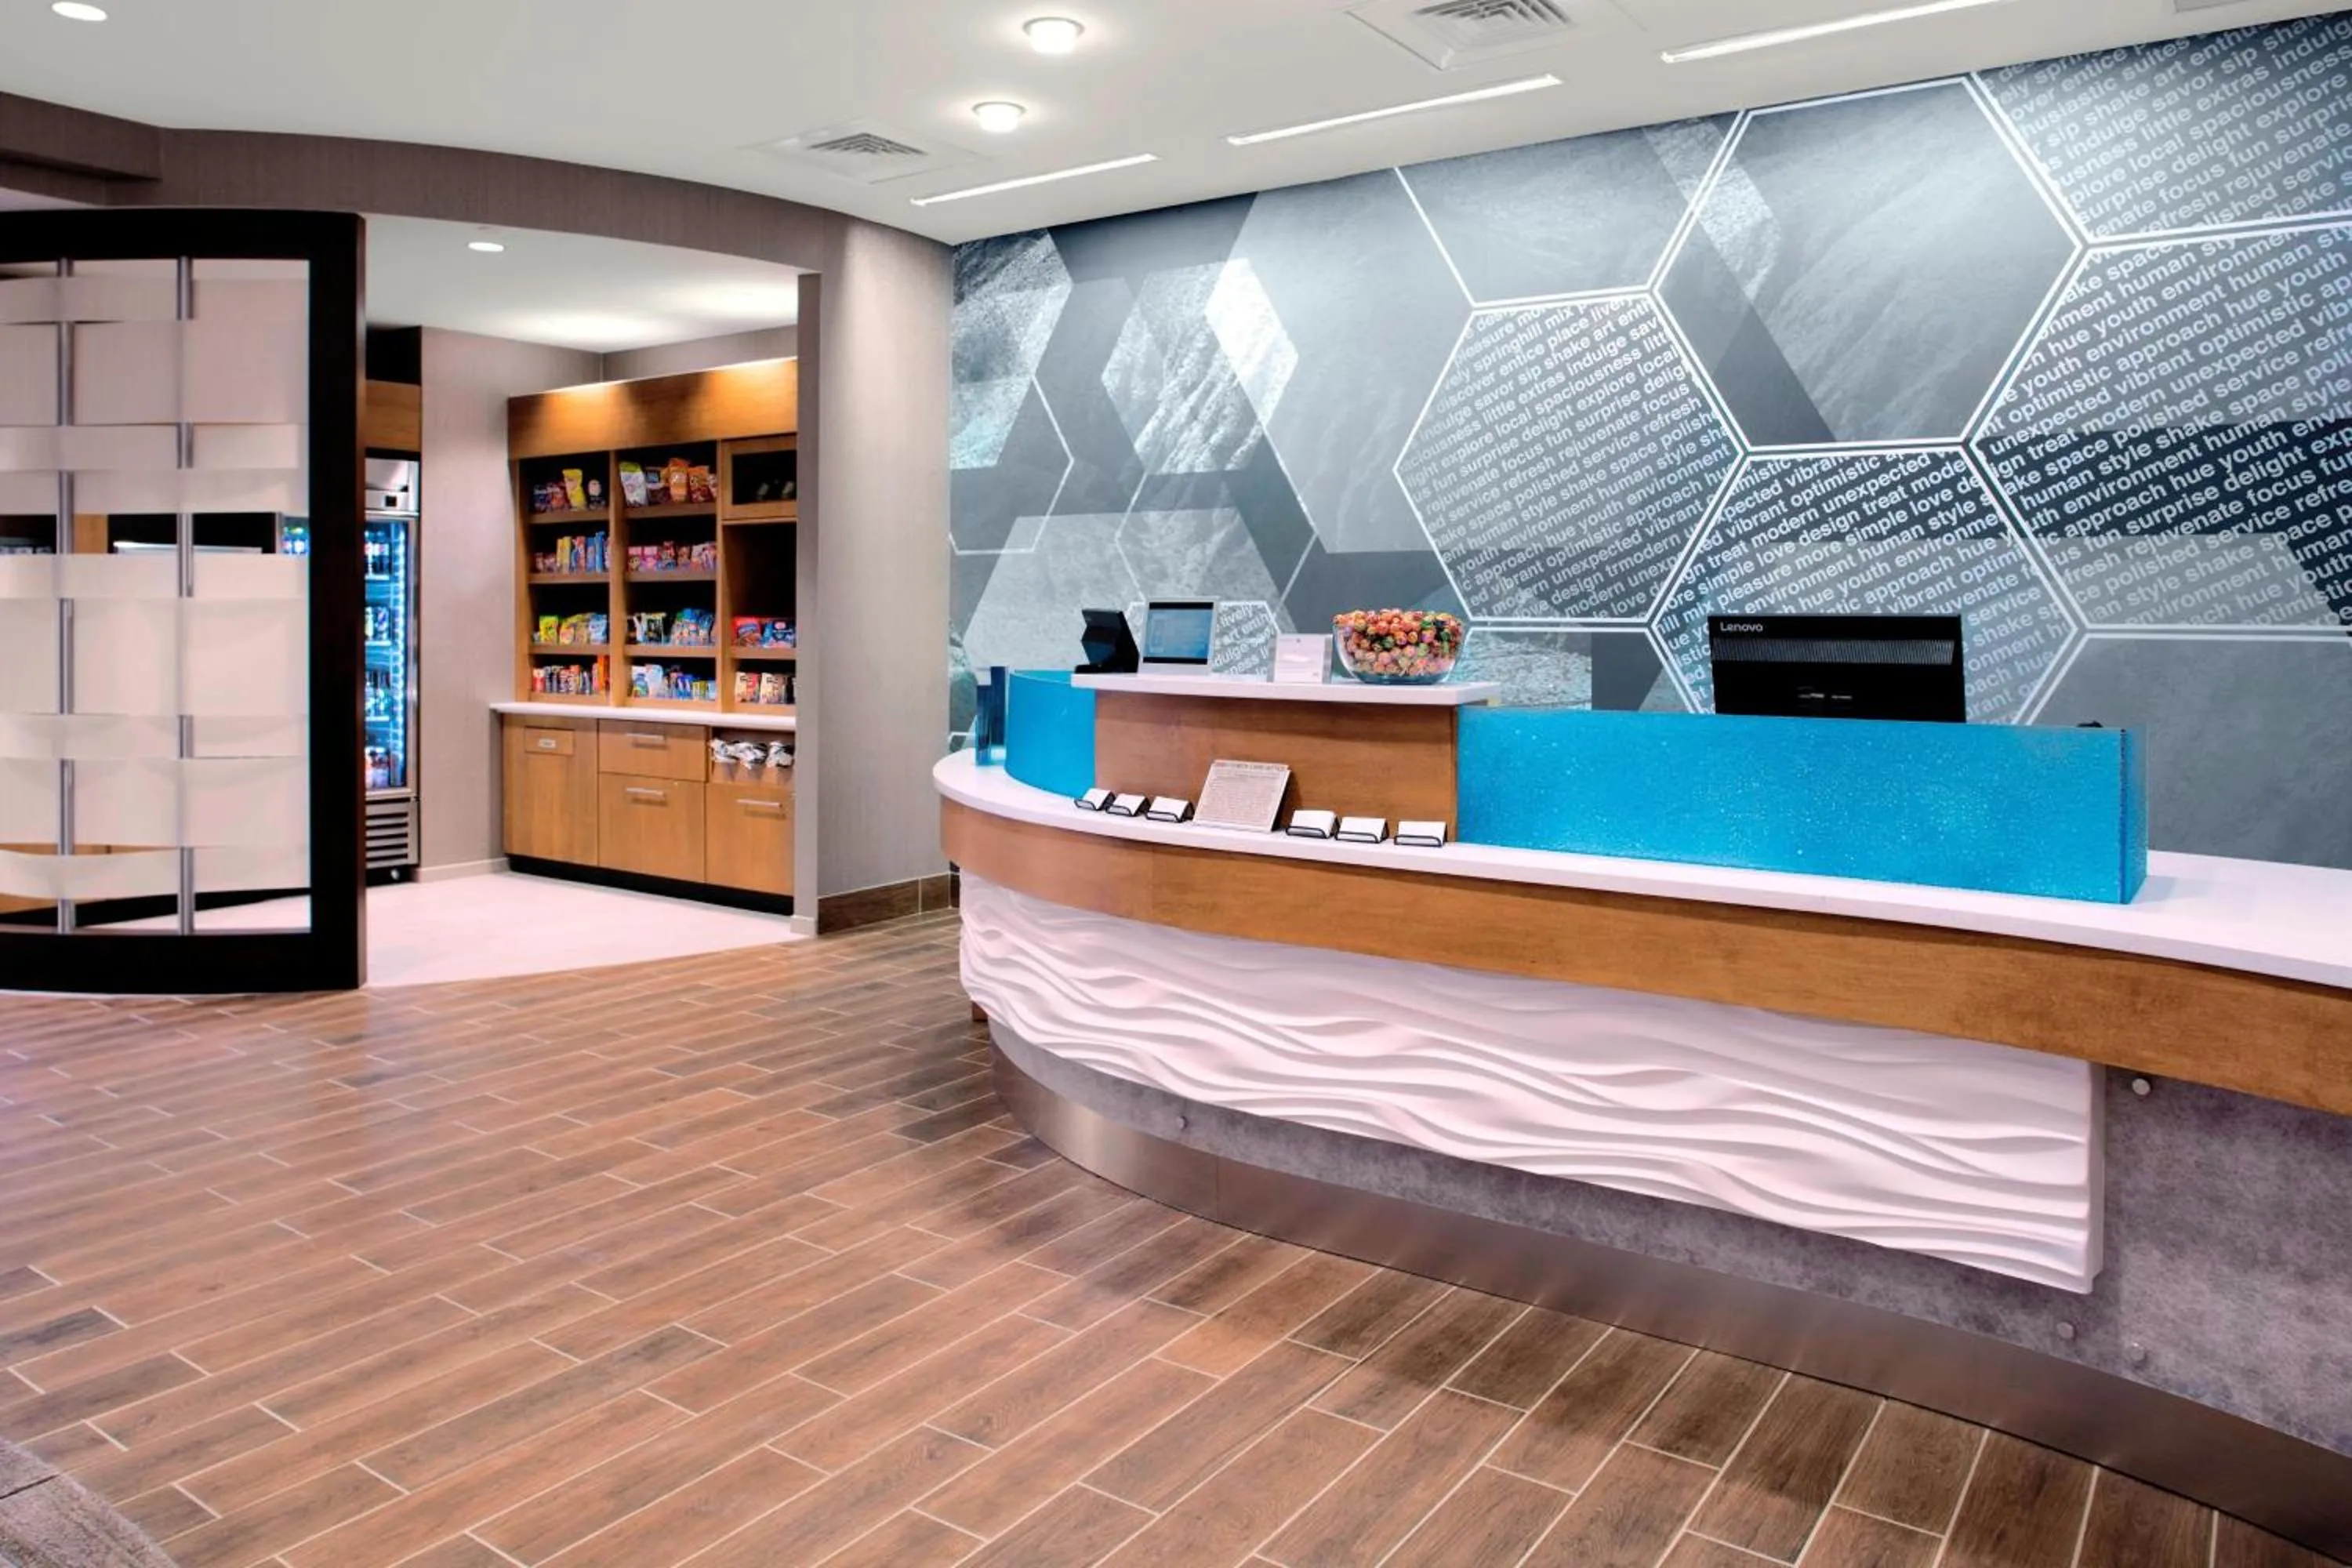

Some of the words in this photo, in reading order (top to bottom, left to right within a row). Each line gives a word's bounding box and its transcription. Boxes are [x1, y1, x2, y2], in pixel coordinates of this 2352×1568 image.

[2046, 122, 2079, 146] sip
[2084, 83, 2150, 125] shake
[2153, 60, 2185, 85] art
[2061, 47, 2128, 90] entice
[2122, 37, 2189, 79] suites
[2063, 108, 2147, 160] indulge
[2152, 69, 2213, 111] savor
[2221, 47, 2257, 72] sip
[2078, 170, 2166, 223] surprise
[2172, 122, 2251, 172] delight
[2256, 74, 2347, 128] explore
[2127, 132, 2186, 172] local
[2189, 45, 2352, 139] spaciousness
[2140, 107, 2192, 142] little
[2196, 65, 2269, 111] extras
[2158, 163, 2225, 205] focus
[2227, 140, 2270, 168] fun
[2223, 122, 2350, 195] rejuvenate
[2116, 252, 2197, 298] human
[1436, 372, 1494, 413] discover
[1499, 344, 1544, 376] entice
[1546, 318, 1589, 351] place
[1474, 321, 1543, 372] springhill
[1544, 306, 1573, 330] mix
[1475, 380, 1514, 410] savor
[1518, 365, 1541, 384] sip
[1544, 336, 1591, 368] shake
[1593, 320, 1615, 340] art
[2008, 366, 2111, 423] optimistic
[2115, 313, 2223, 370] approach
[2223, 289, 2271, 318] hue
[2274, 252, 2347, 297] youth
[2020, 357, 2082, 397] youth
[2085, 283, 2226, 361] environment
[2226, 244, 2313, 292] human
[2046, 329, 2089, 357] hue
[2092, 296, 2158, 338] youth
[1432, 472, 1457, 492] fun
[1459, 437, 1519, 477] surprise
[1522, 404, 1573, 441] delight
[1577, 372, 1635, 410] explore
[1636, 344, 1678, 376] local
[1440, 432, 1494, 468] explore
[1494, 407, 1532, 437] local
[1535, 348, 1641, 414] spaciousness
[1482, 400, 1515, 425] little
[1518, 372, 1564, 404] extras
[1566, 336, 1628, 376] indulge
[1989, 386, 2112, 454] unexpected
[2113, 347, 2193, 394] vibrant
[2198, 292, 2314, 354] optimistic
[2027, 426, 2078, 460] treat
[2080, 388, 2166, 436] modern
[2169, 318, 2307, 393] unexpected
[2045, 438, 2109, 475] space
[2111, 387, 2210, 448] polished
[2213, 350, 2299, 397] service
[1448, 487, 1500, 521] service
[1501, 456, 1556, 492] refresh
[1557, 410, 1640, 462] rejuvenate
[1641, 383, 1689, 415] focus
[1468, 500, 1512, 529] space
[1513, 459, 1580, 509] polished
[1582, 430, 1639, 467] service
[1641, 397, 1702, 436] refresh
[1501, 443, 1544, 473] focus
[1544, 427, 1573, 448] fun
[1576, 389, 1641, 430] surprise
[2019, 470, 2095, 510] human
[2098, 443, 2151, 474] style
[2155, 410, 2224, 448] shake
[2228, 376, 2299, 415] space
[2063, 441, 2201, 514] environment
[2202, 407, 2288, 451] human
[2291, 377, 2351, 412] style
[1474, 542, 1544, 584] approach
[1544, 525, 1575, 547] hue
[1577, 500, 1624, 534] youth
[1627, 442, 1730, 505] environment
[1501, 492, 1595, 550] environment
[1596, 464, 1654, 500] human
[1657, 441, 1697, 469] style
[1521, 495, 1557, 521] style
[1560, 469, 1606, 499] shake
[1610, 441, 1657, 473] space
[1706, 539, 1748, 568] treat
[1750, 508, 1820, 548] modern
[1821, 449, 1932, 512] unexpected
[1725, 499, 1787, 538] vibrant
[1790, 456, 1880, 506] optimistic
[2064, 485, 2167, 537] approach
[2167, 463, 2215, 491] hue
[2217, 431, 2288, 473] youth
[2083, 528, 2123, 552] fun
[2126, 486, 2219, 533] surprise
[2223, 445, 2306, 491] delight
[2124, 500, 2244, 559] rejuvenate
[2245, 470, 2315, 506] focus
[1490, 559, 1544, 594] vibrant
[1546, 522, 1621, 567] optimistic
[1625, 481, 1703, 526] approach
[1551, 528, 1642, 583] unexpected
[1644, 498, 1703, 536] vibrant
[1551, 572, 1604, 604] design
[1605, 533, 1681, 577] trmodern
[1682, 600, 1715, 622] mix
[1715, 564, 1791, 610] pleasure
[1794, 540, 1842, 570] more
[1846, 510, 1907, 545] simple
[1908, 488, 1952, 516] love
[1697, 561, 1754, 593] simple
[1755, 541, 1795, 566] love
[1798, 510, 1860, 546] design
[1861, 485, 1907, 516] treat
[1744, 553, 1856, 614] environment
[1856, 524, 1926, 562] human
[1928, 500, 1976, 529] style
[1864, 555, 1955, 603] approach
[1955, 537, 1996, 562] hue
[2103, 539, 2201, 596] polished
[2205, 505, 2291, 548] service
[2126, 575, 2181, 605] style
[2184, 545, 2255, 582] shake
[2259, 513, 2332, 550] space
[2269, 528, 2352, 572] human
[1563, 582, 1626, 619] modern
[1610, 591, 1646, 615] love
[1720, 622, 1763, 632] Lenovo
[1797, 588, 1834, 612] hue
[1835, 561, 1892, 597] youth
[1886, 575, 1956, 614] vibrant
[1968, 587, 2040, 626] service
[1973, 613, 2033, 646] shake
[2234, 584, 2281, 611] hue
